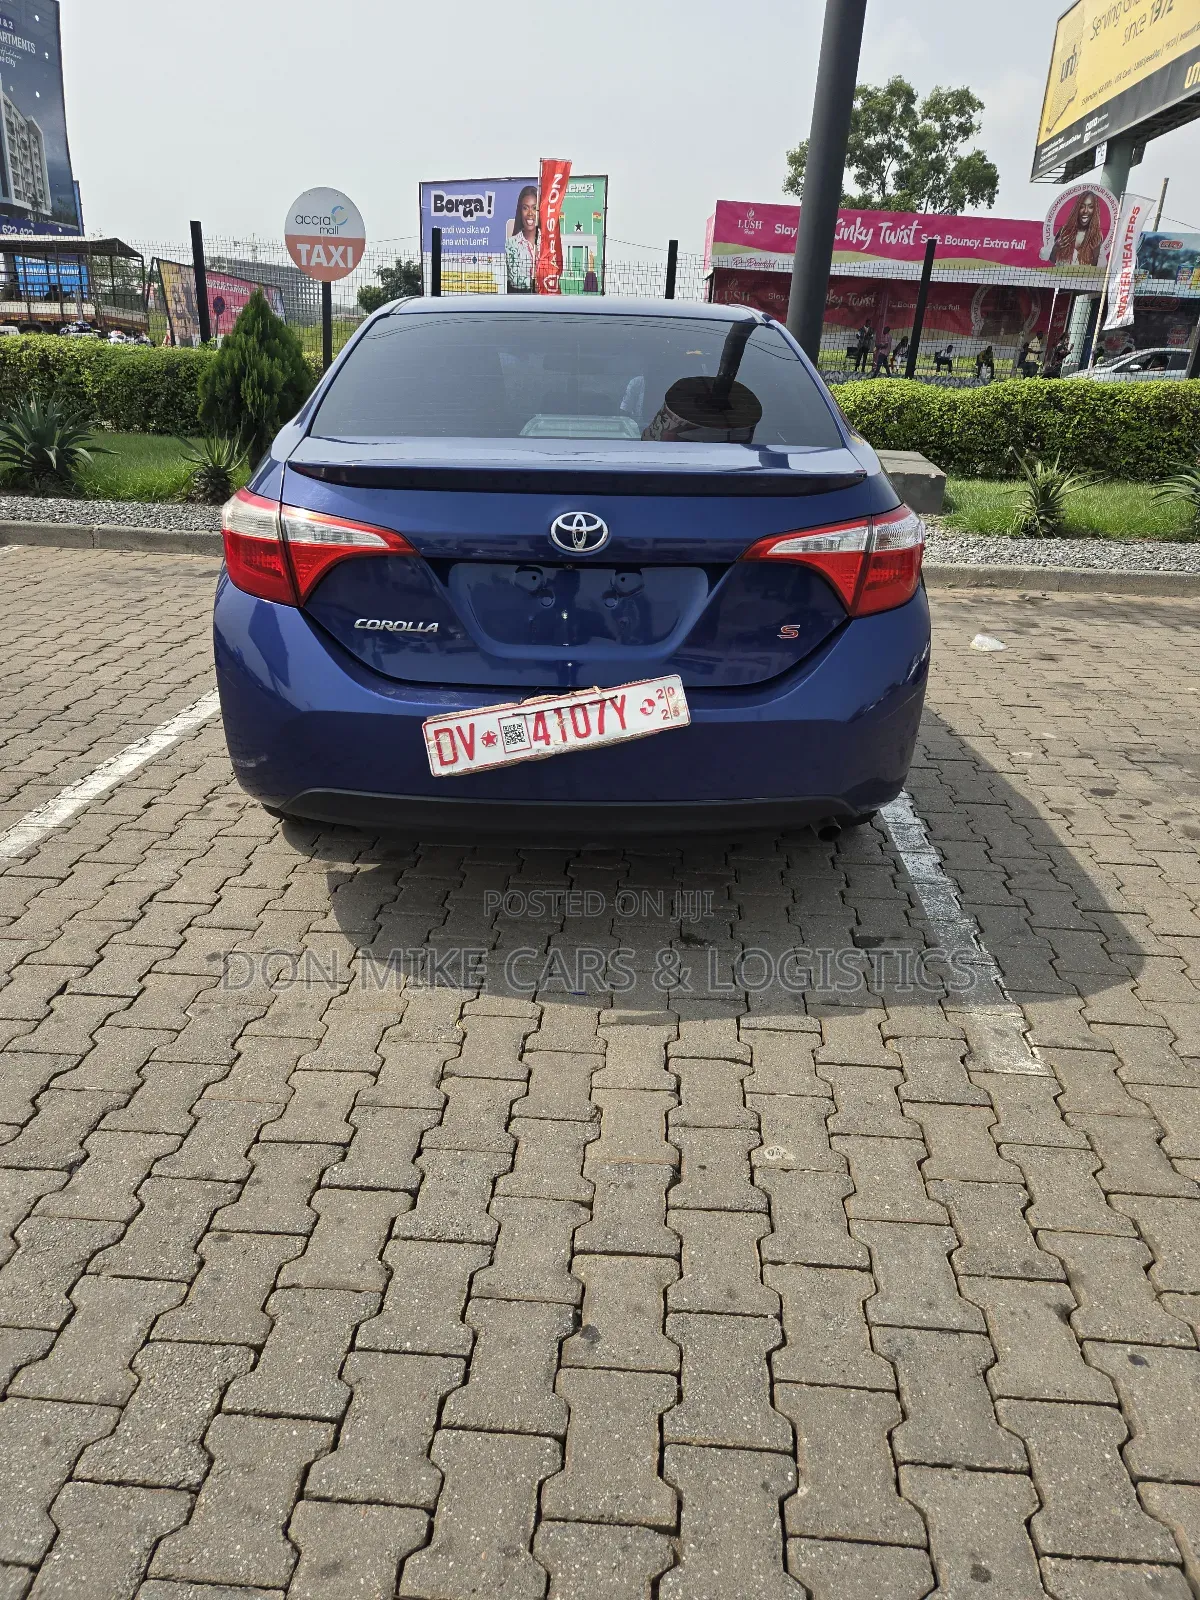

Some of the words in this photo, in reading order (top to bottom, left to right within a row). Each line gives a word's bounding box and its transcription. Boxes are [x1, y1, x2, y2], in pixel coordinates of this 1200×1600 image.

[9, 20, 14, 29] 2
[1122, 13, 1147, 46] since
[433, 194, 493, 218] Borga!
[295, 214, 331, 225] accra
[547, 173, 563, 270] ARISTON
[738, 219, 763, 230] LUSH
[319, 225, 339, 235] mall
[774, 223, 798, 238] Slay
[878, 220, 922, 245] Twist
[1122, 206, 1141, 268] HEATERS
[469, 238, 489, 246] LemFi
[944, 235, 982, 250] Bouncy.
[982, 238, 1009, 249] Extra
[1010, 239, 1027, 250] full
[296, 243, 354, 269] TAXI
[1116, 272, 1132, 319] WATER
[354, 618, 439, 633] COROLLA
[777, 624, 801, 639] S
[433, 722, 475, 767] DV
[533, 694, 626, 746] 4107Y
